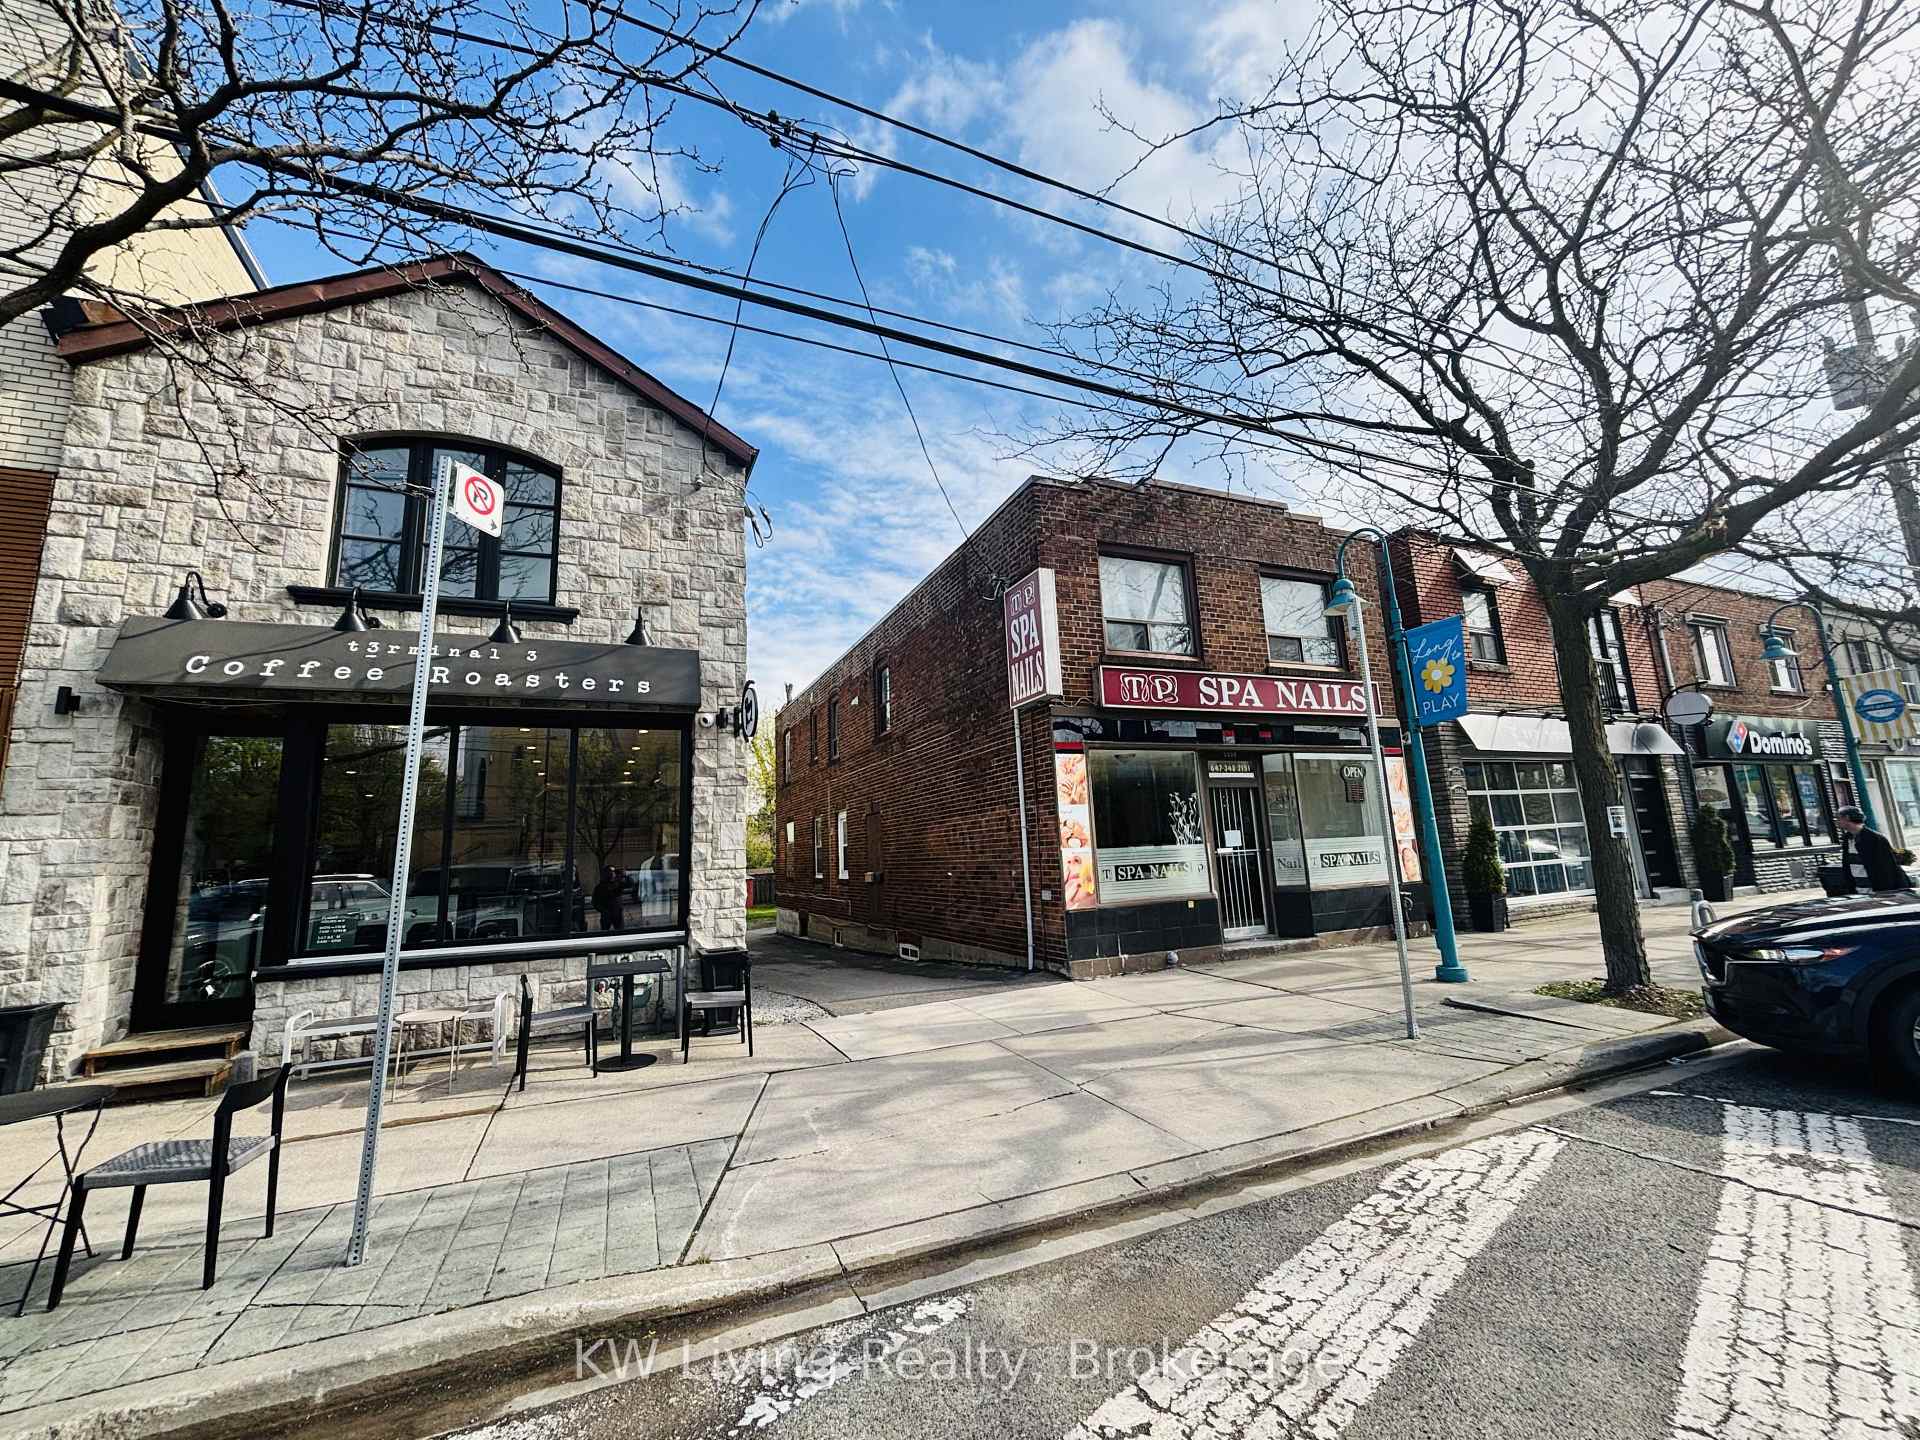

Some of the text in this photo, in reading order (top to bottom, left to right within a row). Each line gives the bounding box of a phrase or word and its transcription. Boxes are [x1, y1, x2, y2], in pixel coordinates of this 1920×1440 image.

[1010, 608, 1040, 659] SPA
[525, 649, 538, 662] 3
[185, 655, 651, 694] Coffee Roasters
[1011, 650, 1044, 702] NAILS
[1198, 676, 1263, 708] SPA
[1273, 681, 1367, 712] NAILS
[1422, 692, 1460, 715] PLAY
[1748, 730, 1813, 755] Domino's
[1343, 766, 1364, 779] OPEN
[1322, 853, 1344, 867] SPA
[1347, 851, 1380, 865] NAILS
[1117, 865, 1144, 880] SPA
